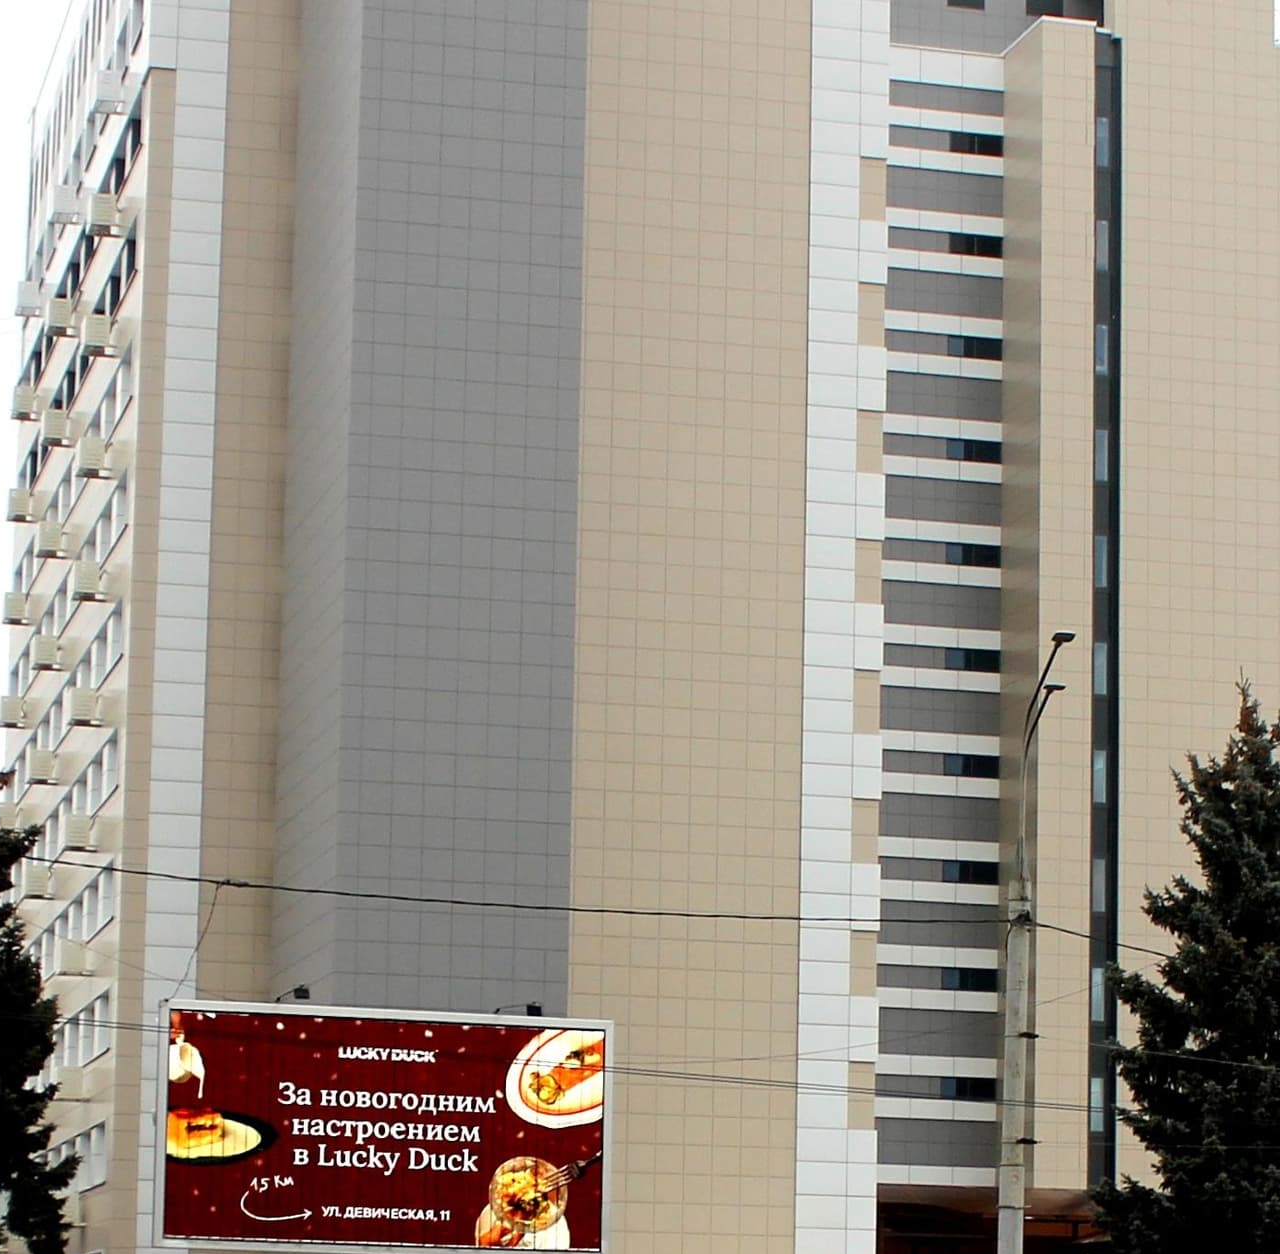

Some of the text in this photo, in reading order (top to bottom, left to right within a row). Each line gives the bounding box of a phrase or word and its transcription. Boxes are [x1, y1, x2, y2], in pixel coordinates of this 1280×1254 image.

[338, 1047, 436, 1063] LUCKY DUCK
[277, 1082, 497, 1116] За новогодним
[292, 1118, 481, 1145] настроением
[293, 1144, 479, 1176] в Lucky Duck
[321, 1206, 451, 1222] УЛ. ДЕВИЧЕСКАЯ, 11
